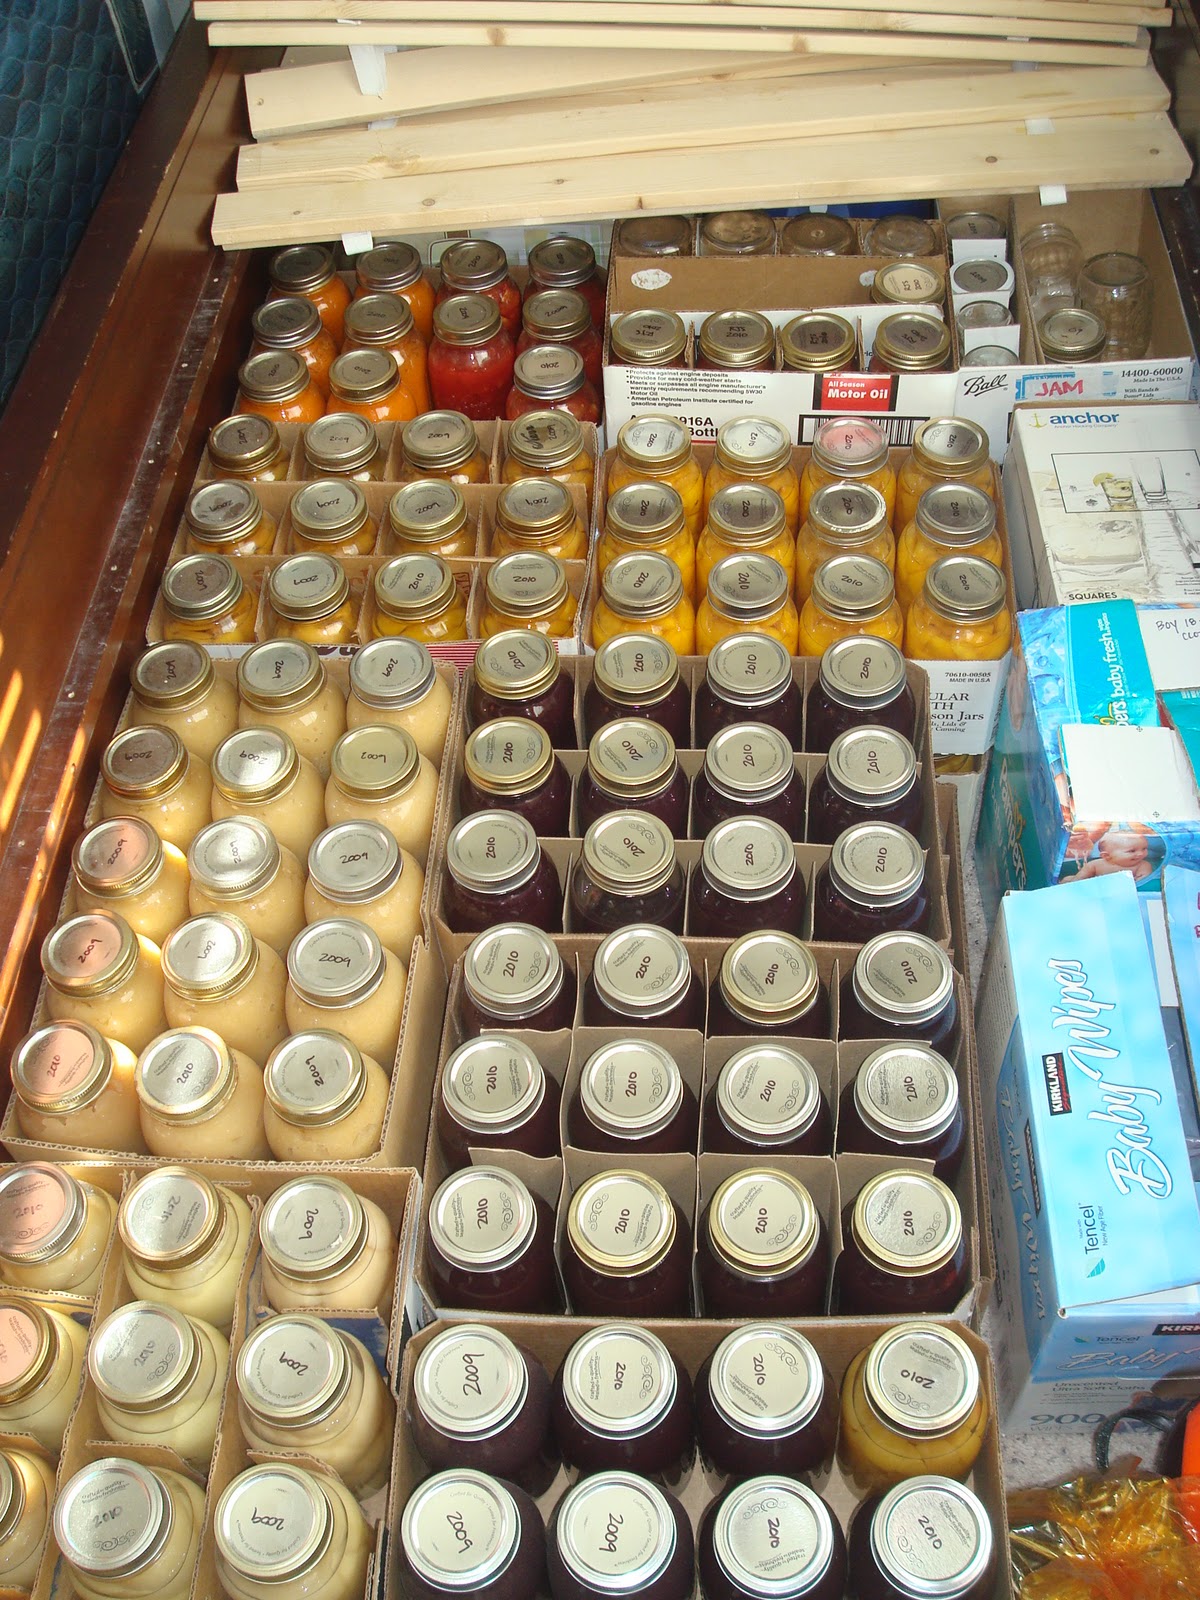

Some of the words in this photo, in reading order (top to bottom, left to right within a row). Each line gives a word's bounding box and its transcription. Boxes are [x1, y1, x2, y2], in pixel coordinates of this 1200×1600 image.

[1121, 367, 1184, 378] 14400-60000
[828, 388, 866, 399] Motor
[870, 389, 888, 399] Oil
[964, 374, 1008, 397] Ball
[1035, 380, 1084, 396] JAM
[1050, 412, 1119, 424] anchor
[748, 432, 758, 446] 2010
[947, 433, 957, 449] 2010
[317, 498, 339, 508] 2009
[416, 502, 440, 514] 2009
[525, 497, 548, 506] 2009
[951, 502, 960, 516] 2010
[195, 570, 207, 591] 2009
[294, 575, 318, 585] 2009
[408, 572, 425, 591] 2010
[634, 572, 649, 588] 2010
[739, 573, 750, 590] 2010
[841, 575, 862, 586] 2010
[959, 575, 969, 590] 2010
[1068, 592, 1118, 600] SQUARES
[1156, 620, 1179, 634] BOY
[1184, 618, 1196, 627] 18
[1099, 632, 1118, 663] fresh
[166, 660, 176, 679] 2009
[273, 661, 284, 678] 2009
[382, 658, 398, 677] 2009
[508, 651, 525, 669] 2010
[634, 653, 644, 672] 2010
[745, 654, 756, 674] 2010
[860, 658, 871, 679] 2010
[1107, 664, 1124, 698] baby
[958, 712, 984, 722] Jars
[124, 750, 153, 762] 2009
[239, 750, 268, 765] 2009
[361, 752, 386, 763] 2009
[503, 742, 513, 763] 2010
[622, 740, 644, 761] 2010
[743, 745, 755, 766] 2010
[867, 751, 880, 773] 2010
[107, 839, 128, 865] 2009
[233, 840, 242, 864] 2009
[340, 852, 368, 863] 2009
[486, 837, 496, 858] 2010
[623, 838, 645, 857] 2010
[745, 844, 753, 865] 2010
[876, 848, 887, 872] 2010
[78, 938, 102, 964] 2009
[197, 940, 216, 960] 2009
[319, 954, 351, 967] 2009
[503, 951, 518, 977] 2010
[636, 956, 650, 978] 2010
[765, 964, 778, 984] 2010
[901, 958, 920, 984] 2010
[1046, 958, 1120, 1082] Wipes
[176, 1062, 195, 1085] 2010
[306, 1056, 324, 1086] 2009
[486, 1066, 497, 1094] 2010
[625, 1072, 637, 1097] 2010
[760, 1080, 775, 1102] 2010
[904, 1076, 918, 1102] 2010
[1046, 1056, 1063, 1112] KIRKLAND
[1088, 1085, 1173, 1200] Baby
[13, 1203, 44, 1219] 2010
[477, 1199, 488, 1229] 2010
[615, 1209, 630, 1234] 2010
[755, 1208, 768, 1233] 2010
[299, 1209, 318, 1239] 2009
[904, 1211, 914, 1235] 2010
[1079, 1206, 1100, 1254] Tencel
[1100, 1221, 1108, 1232] Age
[279, 1352, 308, 1376] 2009
[753, 1354, 766, 1385] 2010
[1056, 1348, 1180, 1370] Baby
[463, 1354, 484, 1395] 2009
[614, 1362, 626, 1390] 2010
[901, 1370, 935, 1388] 2010
[1030, 1413, 1106, 1424] 900
[92, 1505, 123, 1529] 2010
[251, 1507, 284, 1530] 2009
[447, 1512, 473, 1553] 2009
[599, 1513, 623, 1552] 2009
[768, 1518, 779, 1548] 2010
[918, 1516, 942, 1549] 2010
